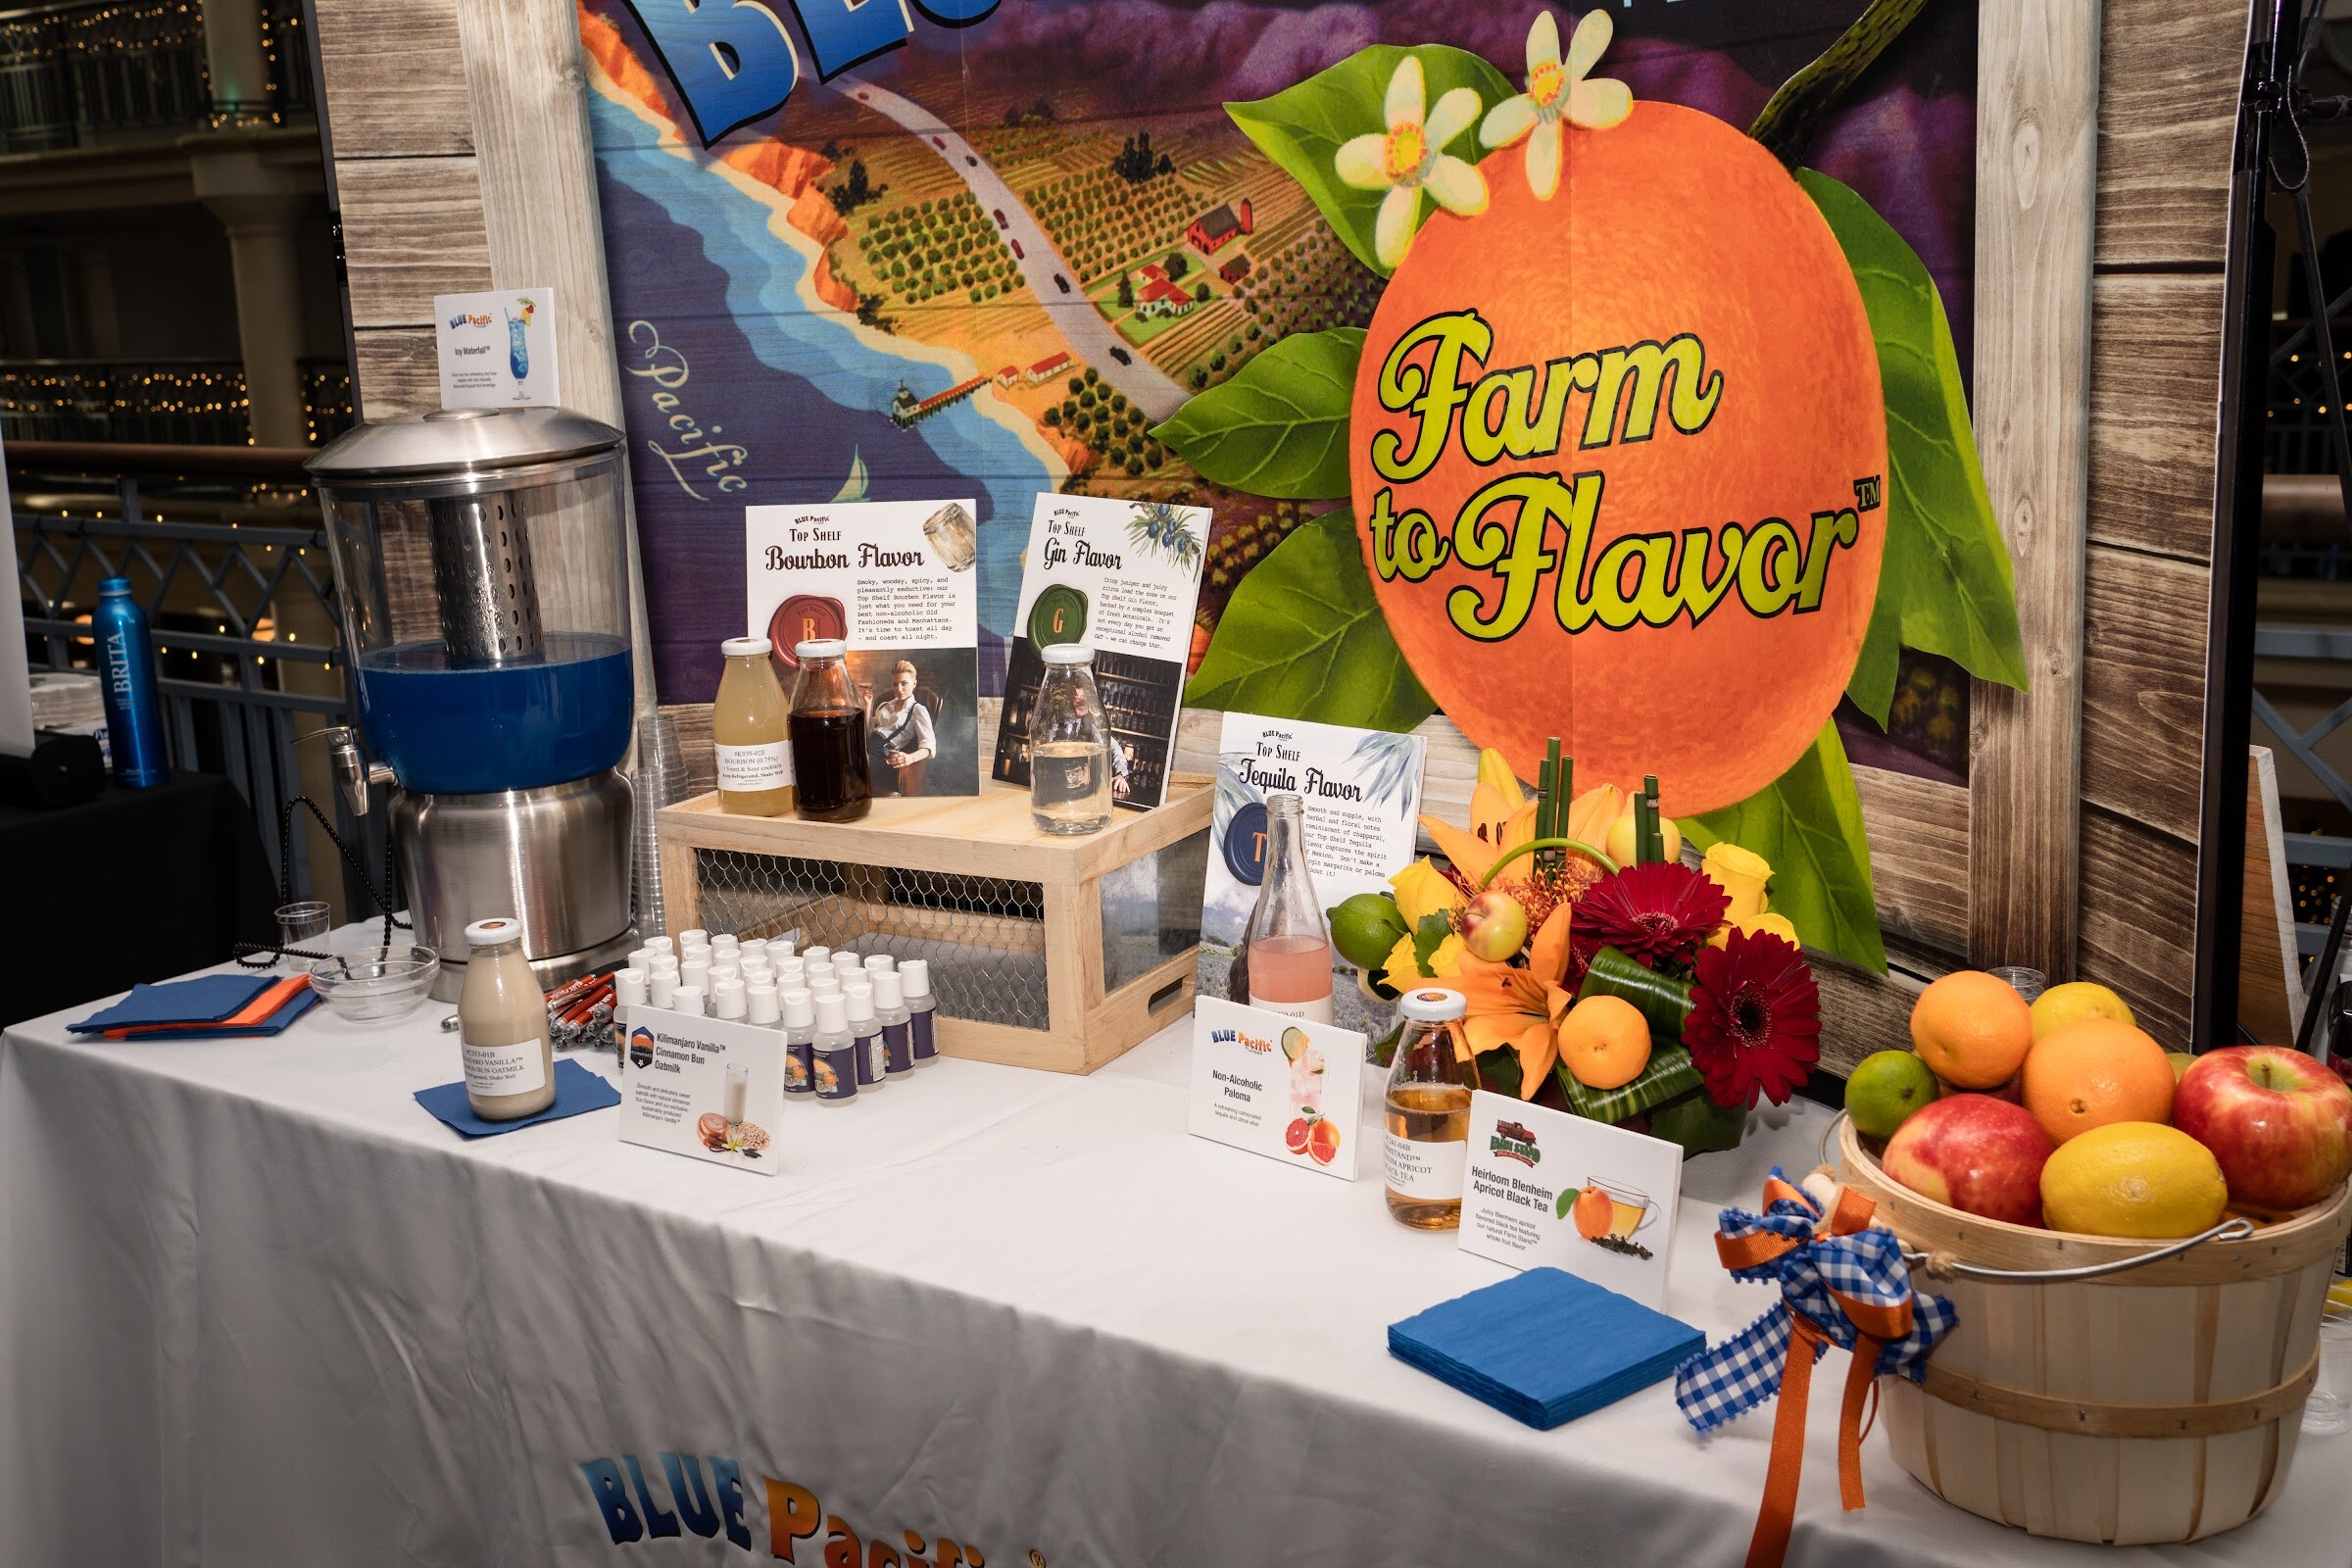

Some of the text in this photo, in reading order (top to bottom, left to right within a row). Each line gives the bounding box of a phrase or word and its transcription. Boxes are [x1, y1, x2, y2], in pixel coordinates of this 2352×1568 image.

[450, 314, 492, 329] BLUE Pacific
[1370, 308, 1725, 484] Farm
[623, 319, 747, 501] Pacific
[795, 514, 830, 524] BLUE Pacific
[1368, 486, 1451, 586] to
[765, 543, 924, 570] Bourbon Flavor
[1044, 537, 1122, 570] Gin Flavor
[1054, 609, 1063, 633] G
[1123, 612, 1152, 622] botanicals.
[1096, 626, 1126, 635] exceptional
[108, 631, 132, 694] BRITA
[1275, 731, 1293, 740] Pacific
[1239, 759, 1362, 803] Tequila Flavor
[1342, 819, 1360, 828] floral
[1343, 811, 1364, 820] supple,
[1305, 824, 1341, 833] reminiscent
[1252, 832, 1267, 862] T
[1330, 835, 1346, 844] Shelf
[1349, 839, 1371, 848] Tequila
[1324, 861, 1352, 871] margarita
[657, 1032, 695, 1049] Kilimanjaro
[1211, 1029, 1273, 1053] BLUE Pacific
[656, 1047, 705, 1064] Cinnamon Bun
[492, 1064, 524, 1073] OATMILK
[655, 1060, 680, 1074] Oatmilk
[1212, 1069, 1262, 1091] Non-Alcoholic
[1224, 1088, 1250, 1102] Paloma
[1490, 1136, 1513, 1152] FARM
[1398, 1162, 1432, 1173] APRICOT
[1400, 1172, 1414, 1181] TEA
[1472, 1166, 1553, 1200] Heirloom Blenheim
[1473, 1180, 1547, 1212] Apricot Black Tea
[1476, 1213, 1494, 1224] flavored
[1495, 1220, 1508, 1229] black
[1519, 1227, 1540, 1240] featuring
[1495, 1211, 1517, 1223] Blenheim
[1519, 1220, 1536, 1229] apricot
[1487, 1226, 1502, 1235] natural
[1512, 1242, 1526, 1250] flavor
[579, 1451, 753, 1552] BLUE
